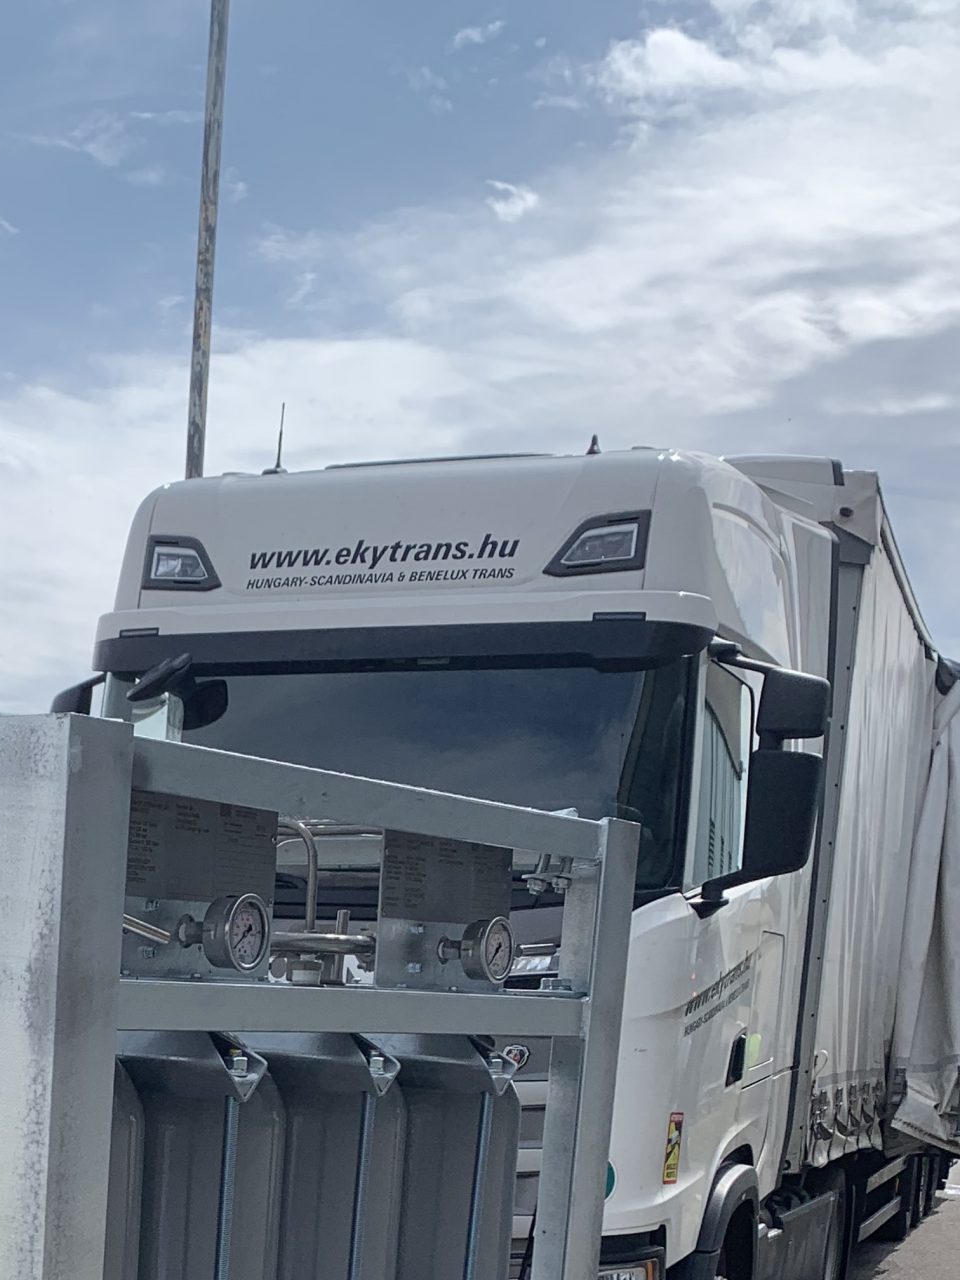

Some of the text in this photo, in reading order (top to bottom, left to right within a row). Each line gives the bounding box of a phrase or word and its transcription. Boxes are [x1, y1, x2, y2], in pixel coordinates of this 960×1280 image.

[249, 533, 520, 569] www.ekytrans.hu
[246, 567, 515, 589] HUNGARY-SCANDINAVIA & BENELUX TRANS
